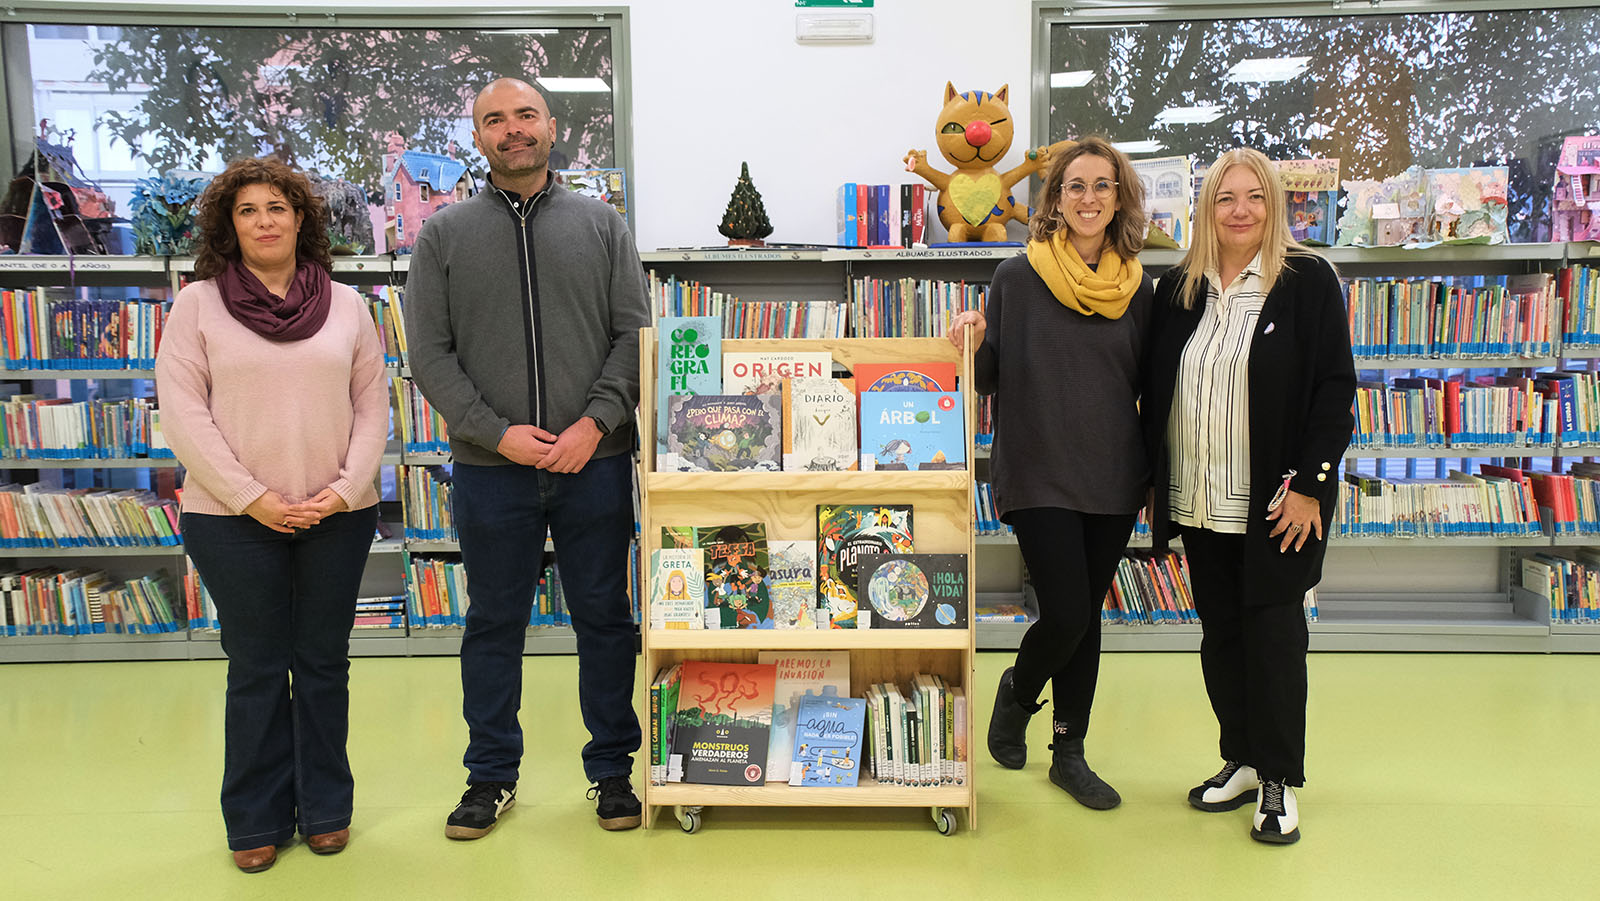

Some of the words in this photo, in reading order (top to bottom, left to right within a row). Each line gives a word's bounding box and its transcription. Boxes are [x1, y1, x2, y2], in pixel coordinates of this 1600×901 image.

[671, 328, 698, 343] CO
[671, 344, 710, 358] REO
[670, 360, 709, 374] GRA
[733, 362, 822, 378] ORIGEN
[671, 375, 686, 390] FI
[805, 394, 844, 403] DIARIO
[724, 406, 740, 414] PASA
[742, 407, 756, 416] CON
[880, 408, 940, 425] ÁRBOL
[704, 414, 746, 426] CLIMA?
[933, 572, 964, 584] ¡HOLA
[933, 585, 963, 597] VIDA!
[775, 658, 816, 669] PAREMOS
[820, 658, 831, 668] LA
[807, 718, 845, 737] agua
[692, 742, 749, 751] MONSTRUOS
[692, 749, 749, 759] VERDADEROS
